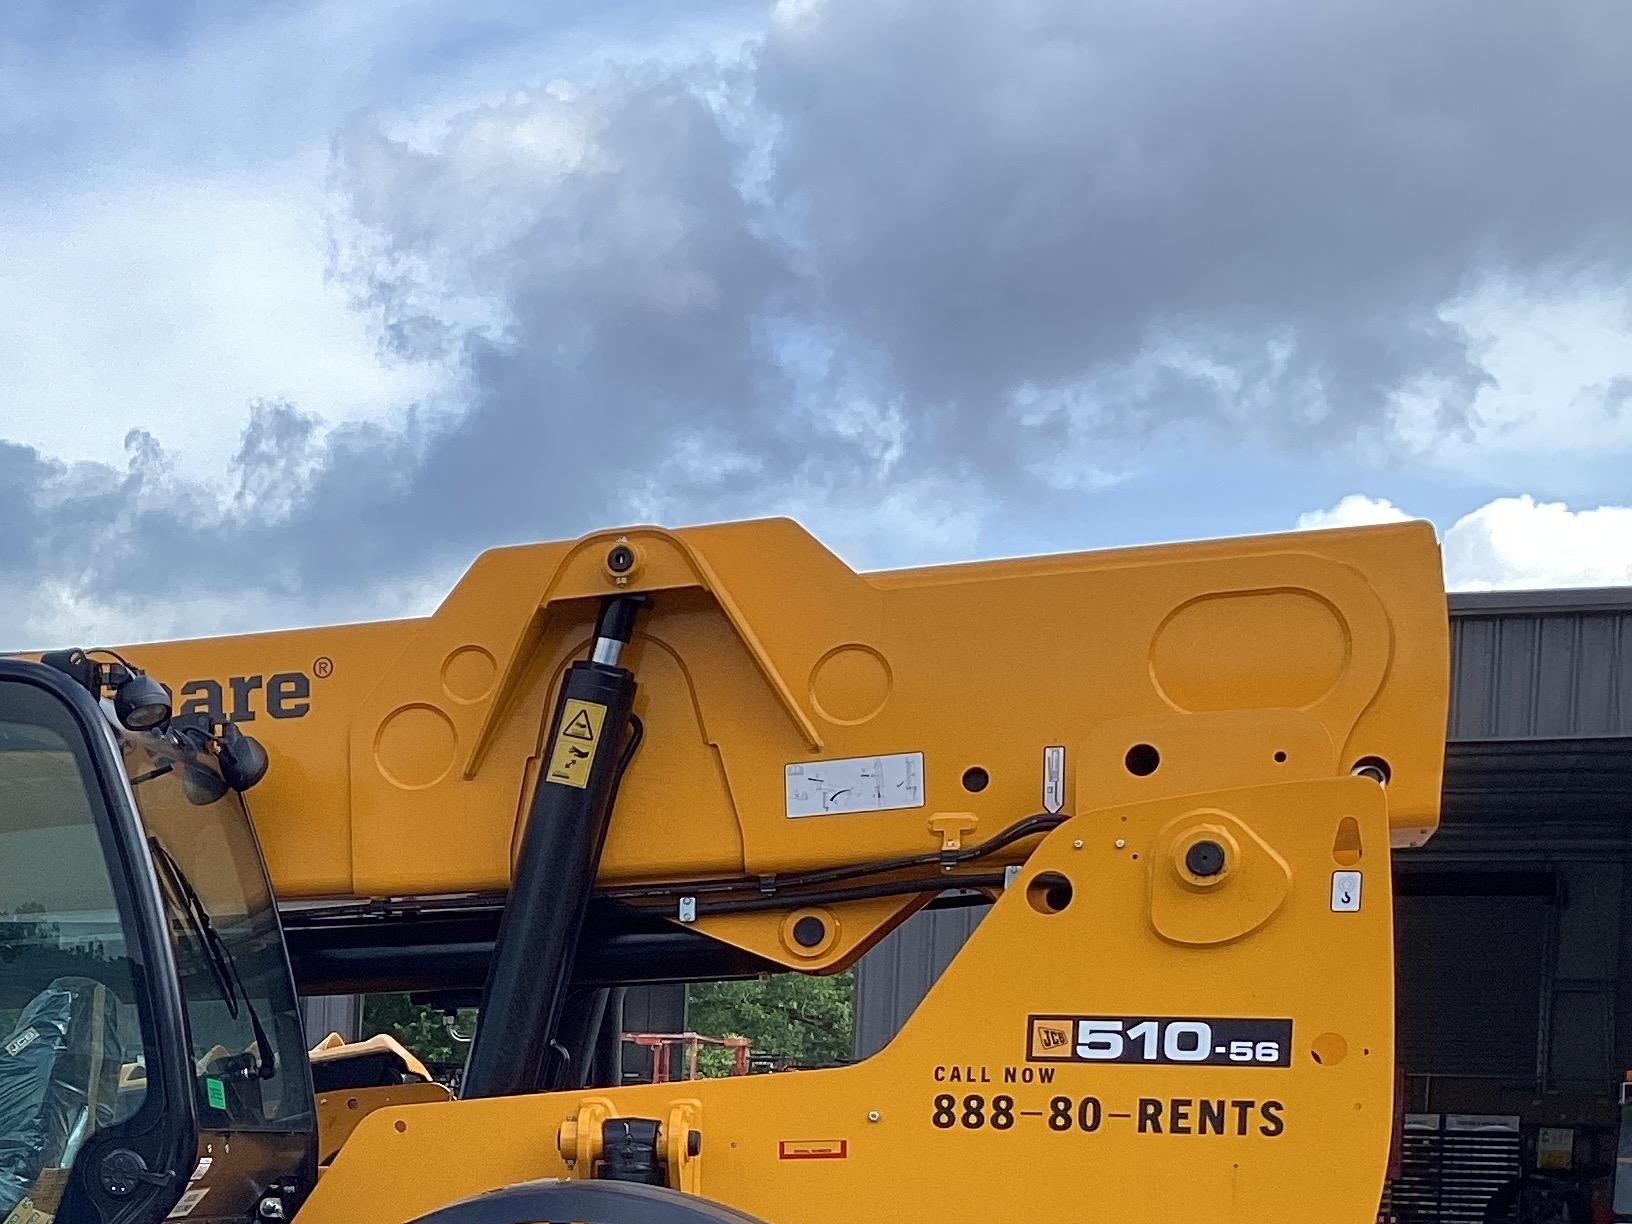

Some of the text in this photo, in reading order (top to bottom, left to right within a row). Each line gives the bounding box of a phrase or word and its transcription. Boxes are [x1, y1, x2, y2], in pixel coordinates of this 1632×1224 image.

[1043, 1029, 1066, 1047] JCB
[934, 1066, 1056, 1084] CALL NOW
